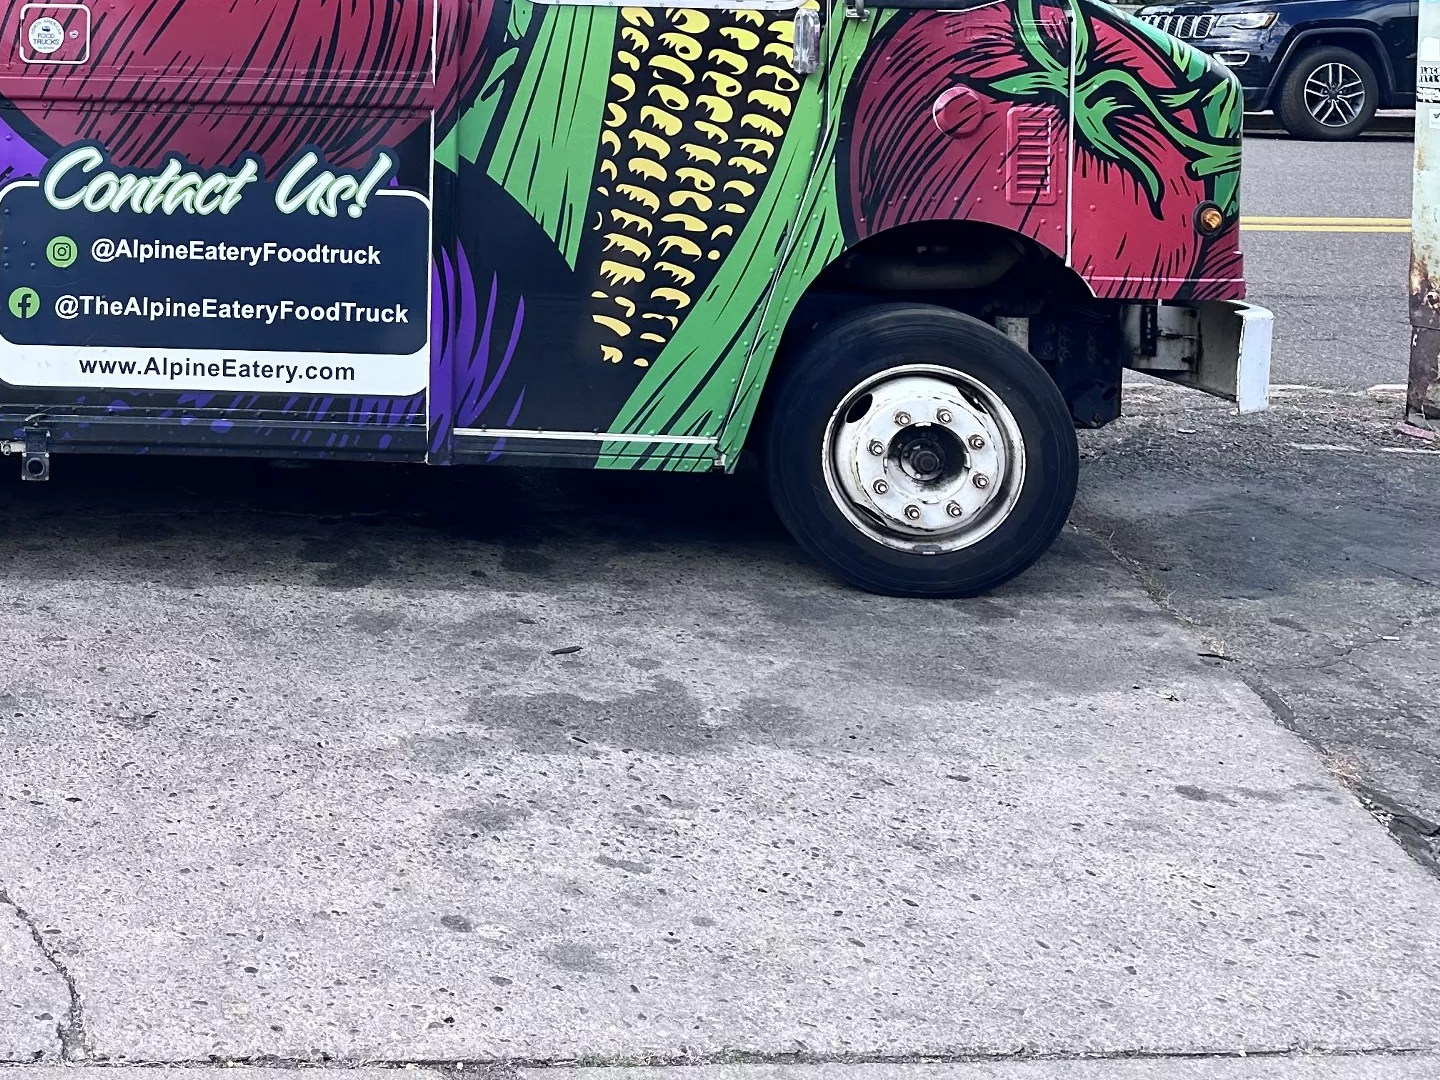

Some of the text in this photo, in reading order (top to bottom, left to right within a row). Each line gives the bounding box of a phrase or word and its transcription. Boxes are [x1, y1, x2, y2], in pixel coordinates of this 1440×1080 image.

[33, 38, 60, 46] TRUCKS
[44, 145, 393, 218] Contact Us!
[91, 238, 381, 266] @AlpineEateryFoodtruck
[55, 295, 409, 324] @TheAlpineEateryFoodTruck
[78, 356, 356, 381] www.AlpineEatery.com
